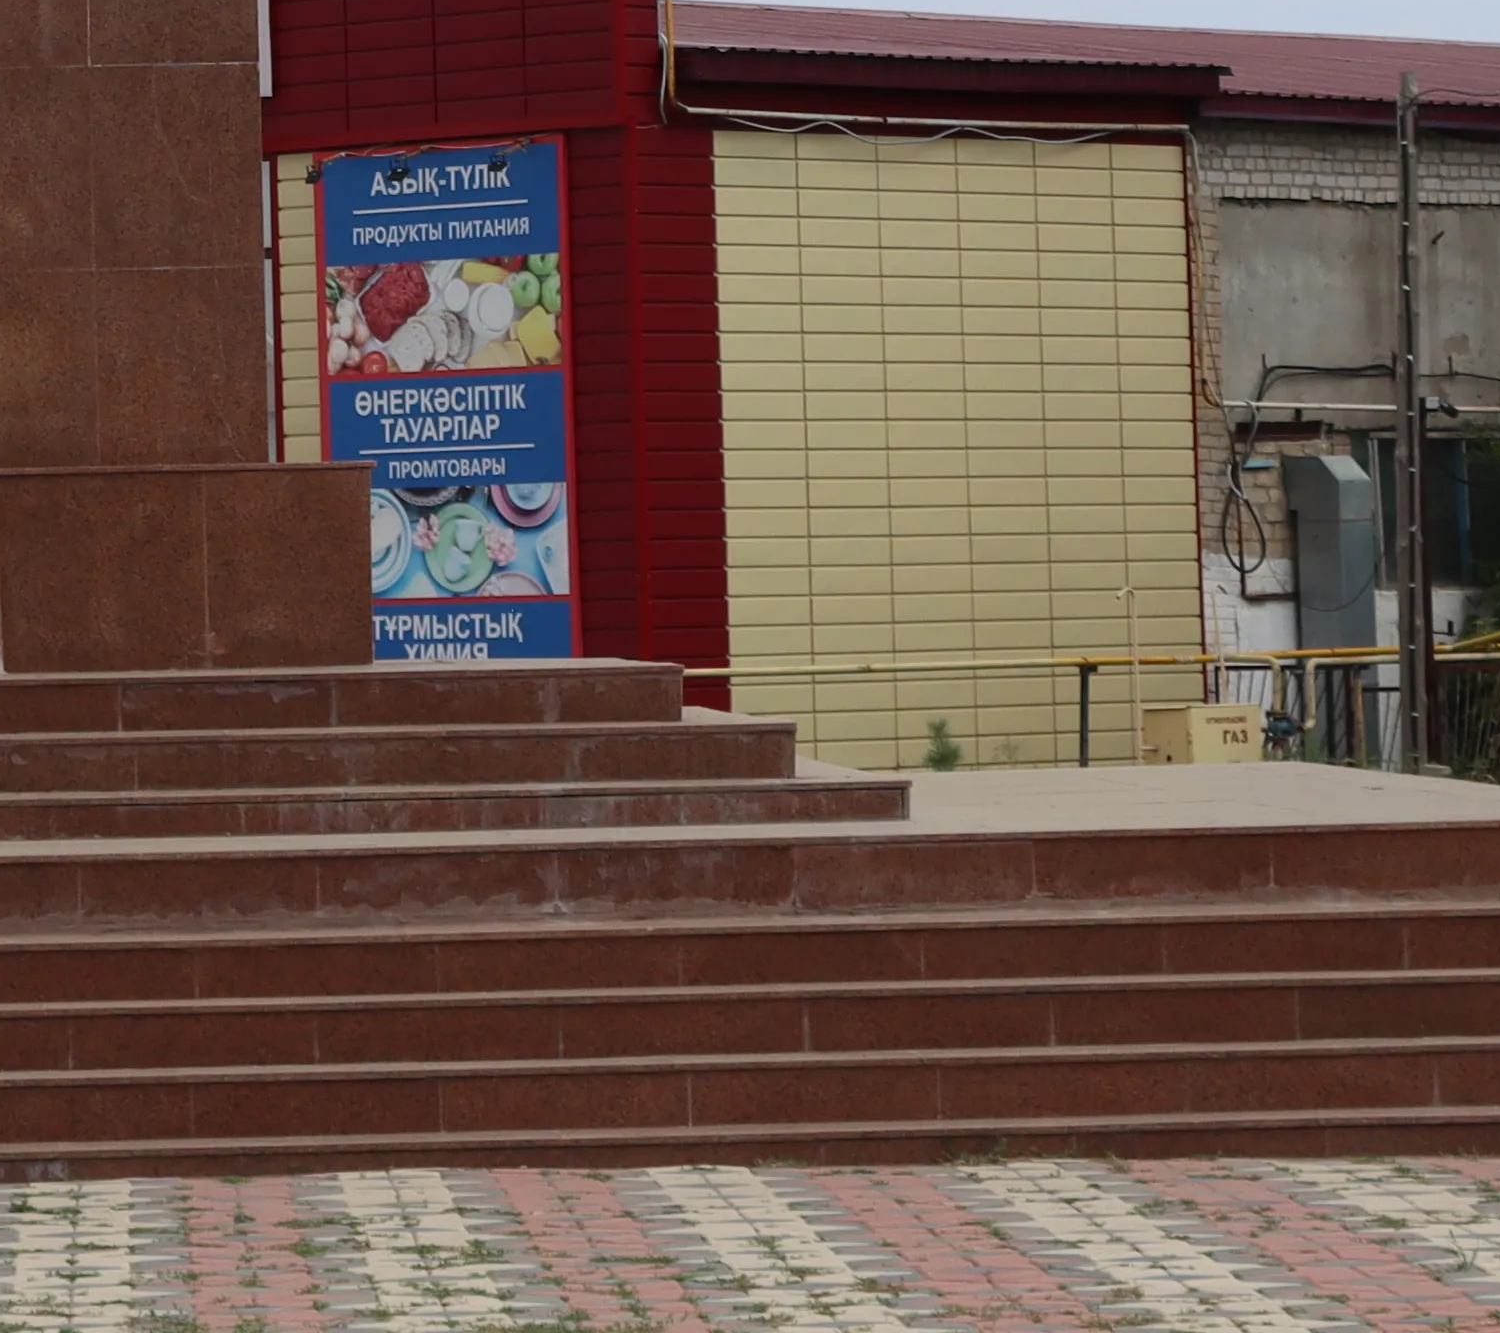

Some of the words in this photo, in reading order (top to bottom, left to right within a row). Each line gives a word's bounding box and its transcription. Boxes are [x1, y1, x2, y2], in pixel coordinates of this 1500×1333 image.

[352, 222, 443, 248] ПРОДУКТЫ
[448, 216, 530, 240] ПИТАНИЯ
[355, 384, 526, 416] ӨНЕРКӘСІПТІК
[380, 413, 501, 444] ТАУАРЛАР
[388, 457, 506, 479] ПРОМТОВАРЫ
[372, 613, 523, 643] ТҰРМЫСТЫҚ
[1222, 729, 1249, 745] ГАЗ
